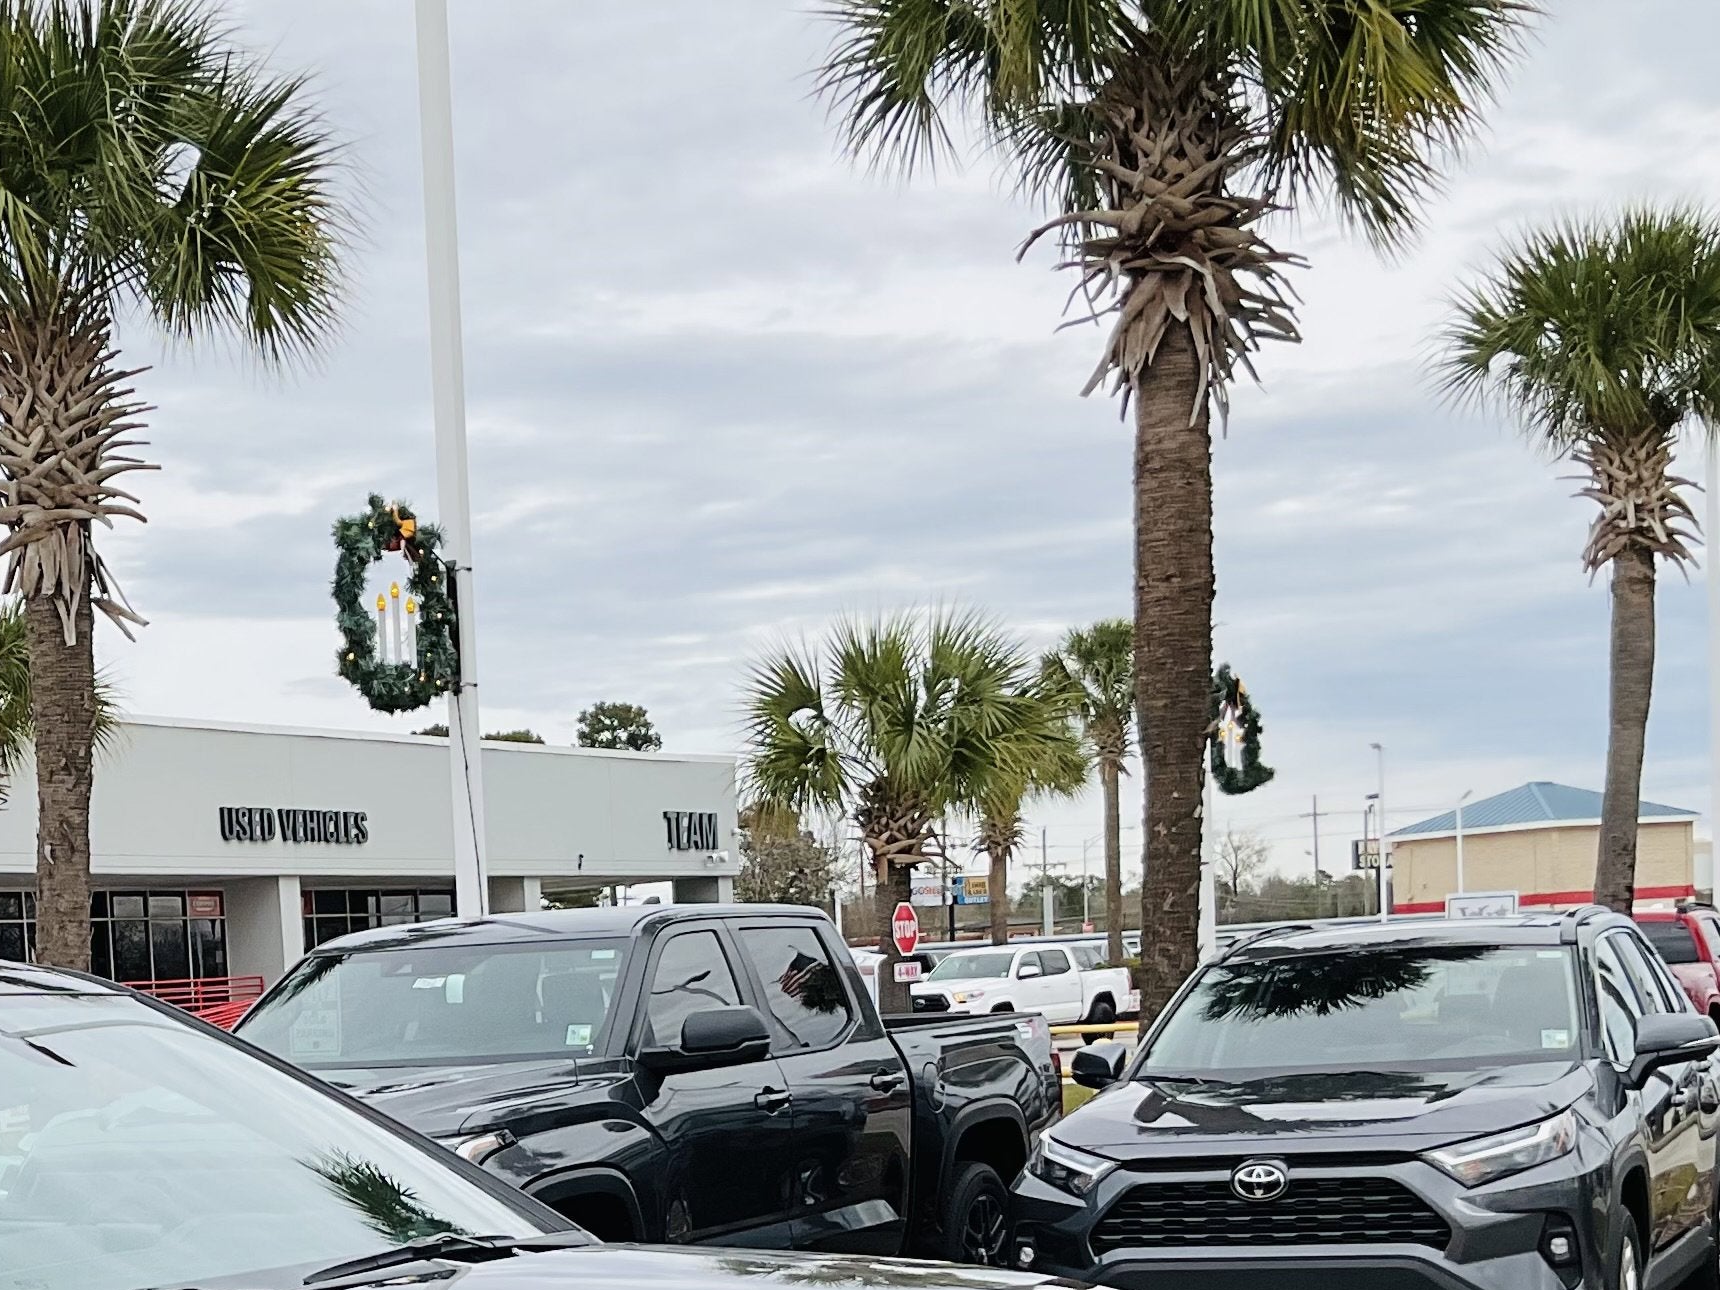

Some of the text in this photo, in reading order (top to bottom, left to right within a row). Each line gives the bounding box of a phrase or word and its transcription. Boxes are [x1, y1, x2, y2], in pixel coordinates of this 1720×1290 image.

[219, 806, 369, 845] USED VEHICLES
[662, 811, 719, 850] TEAM
[894, 919, 916, 939] STOP
